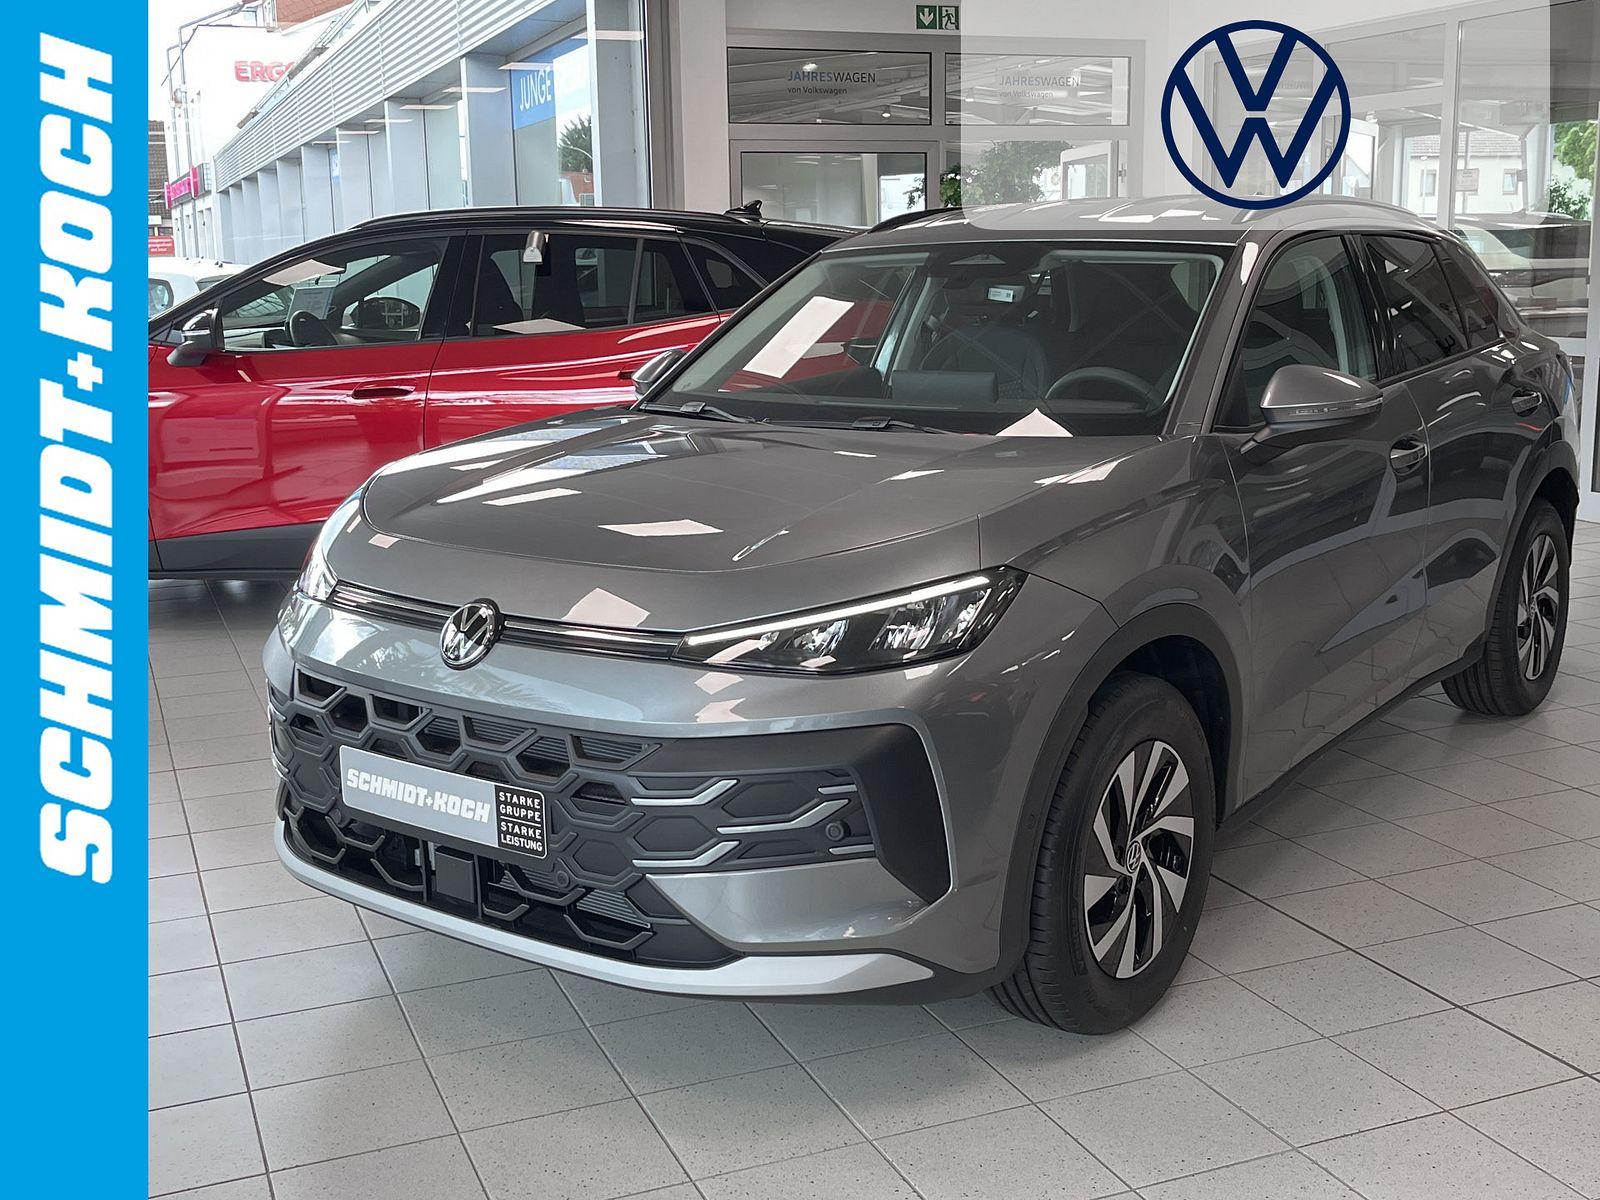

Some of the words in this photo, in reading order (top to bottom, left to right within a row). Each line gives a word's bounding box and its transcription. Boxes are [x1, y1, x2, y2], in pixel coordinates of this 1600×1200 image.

[787, 71, 876, 83] JAHRESWAGEN
[999, 75, 1080, 87] JAHRESWAGEN
[520, 66, 552, 112] JUNGE
[803, 86, 848, 96] Volkswagen
[346, 768, 491, 823] SCHMIDT+KOCH
[499, 791, 541, 809] STARKE
[500, 804, 541, 822] GRUPPE
[500, 821, 542, 839] STARKE
[501, 833, 543, 852] LEISTUNG
